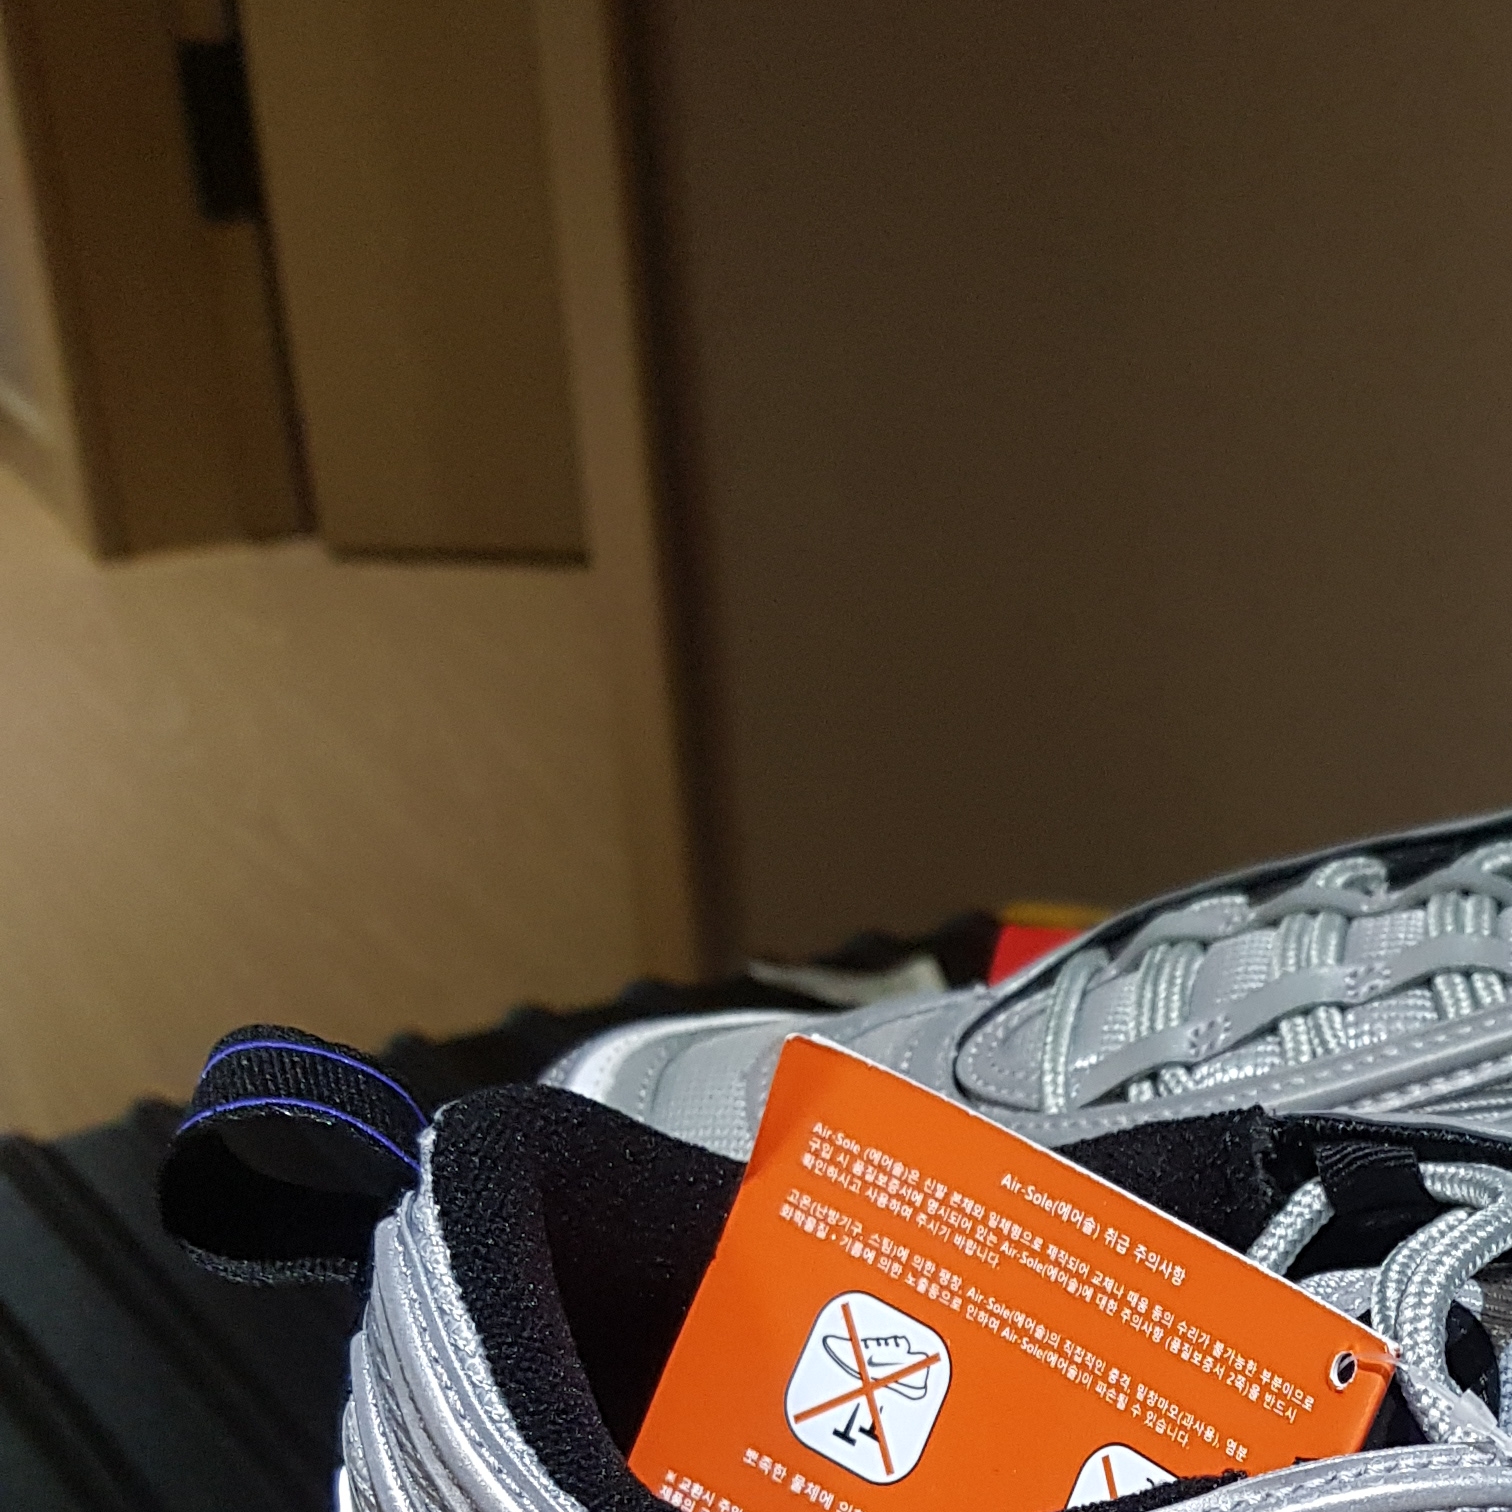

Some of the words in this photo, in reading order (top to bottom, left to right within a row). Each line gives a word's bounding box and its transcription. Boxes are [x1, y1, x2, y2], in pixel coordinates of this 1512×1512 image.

[801, 1152, 862, 1194] 확인하시고
[864, 1186, 914, 1222] 사용하여
[915, 1211, 951, 1242] 주시기
[808, 1136, 834, 1160] 구입
[836, 1152, 850, 1169] 시
[851, 1158, 925, 1208] 품질보증서에
[974, 1224, 998, 1247] 있는
[1095, 1293, 1118, 1317] 대한
[1120, 1307, 1164, 1343] 주의사항
[1164, 1335, 1226, 1380] (품질보증서
[1226, 1371, 1261, 1402] 2쪽)을
[1263, 1392, 1297, 1423] 반드시
[812, 1121, 861, 1155] Air-Sole
[923, 1177, 948, 1200] 신발
[949, 1191, 985, 1221] 본체와
[987, 1211, 1044, 1252] 일체형으로
[1090, 1270, 1125, 1299] 교체나
[1151, 1304, 1175, 1329] 등의
[1176, 1320, 1211, 1350] 수리가
[1212, 1340, 1257, 1378] 불가능한
[1259, 1368, 1315, 1412] 부분이므로
[1103, 1227, 1131, 1255] 취급
[1133, 1243, 1186, 1286] 주의사항
[877, 1256, 903, 1279] 의한
[965, 1303, 1001, 1333] 인하여
[1094, 1380, 1129, 1411] 파손될
[1130, 1403, 1142, 1418] 수
[1143, 1410, 1193, 1449] 있습니다.
[911, 1254, 936, 1278] 의한
[1063, 1339, 1106, 1376] 직접적인
[677, 1477, 716, 1508] 교환시
[789, 1473, 835, 1511] 물체에
